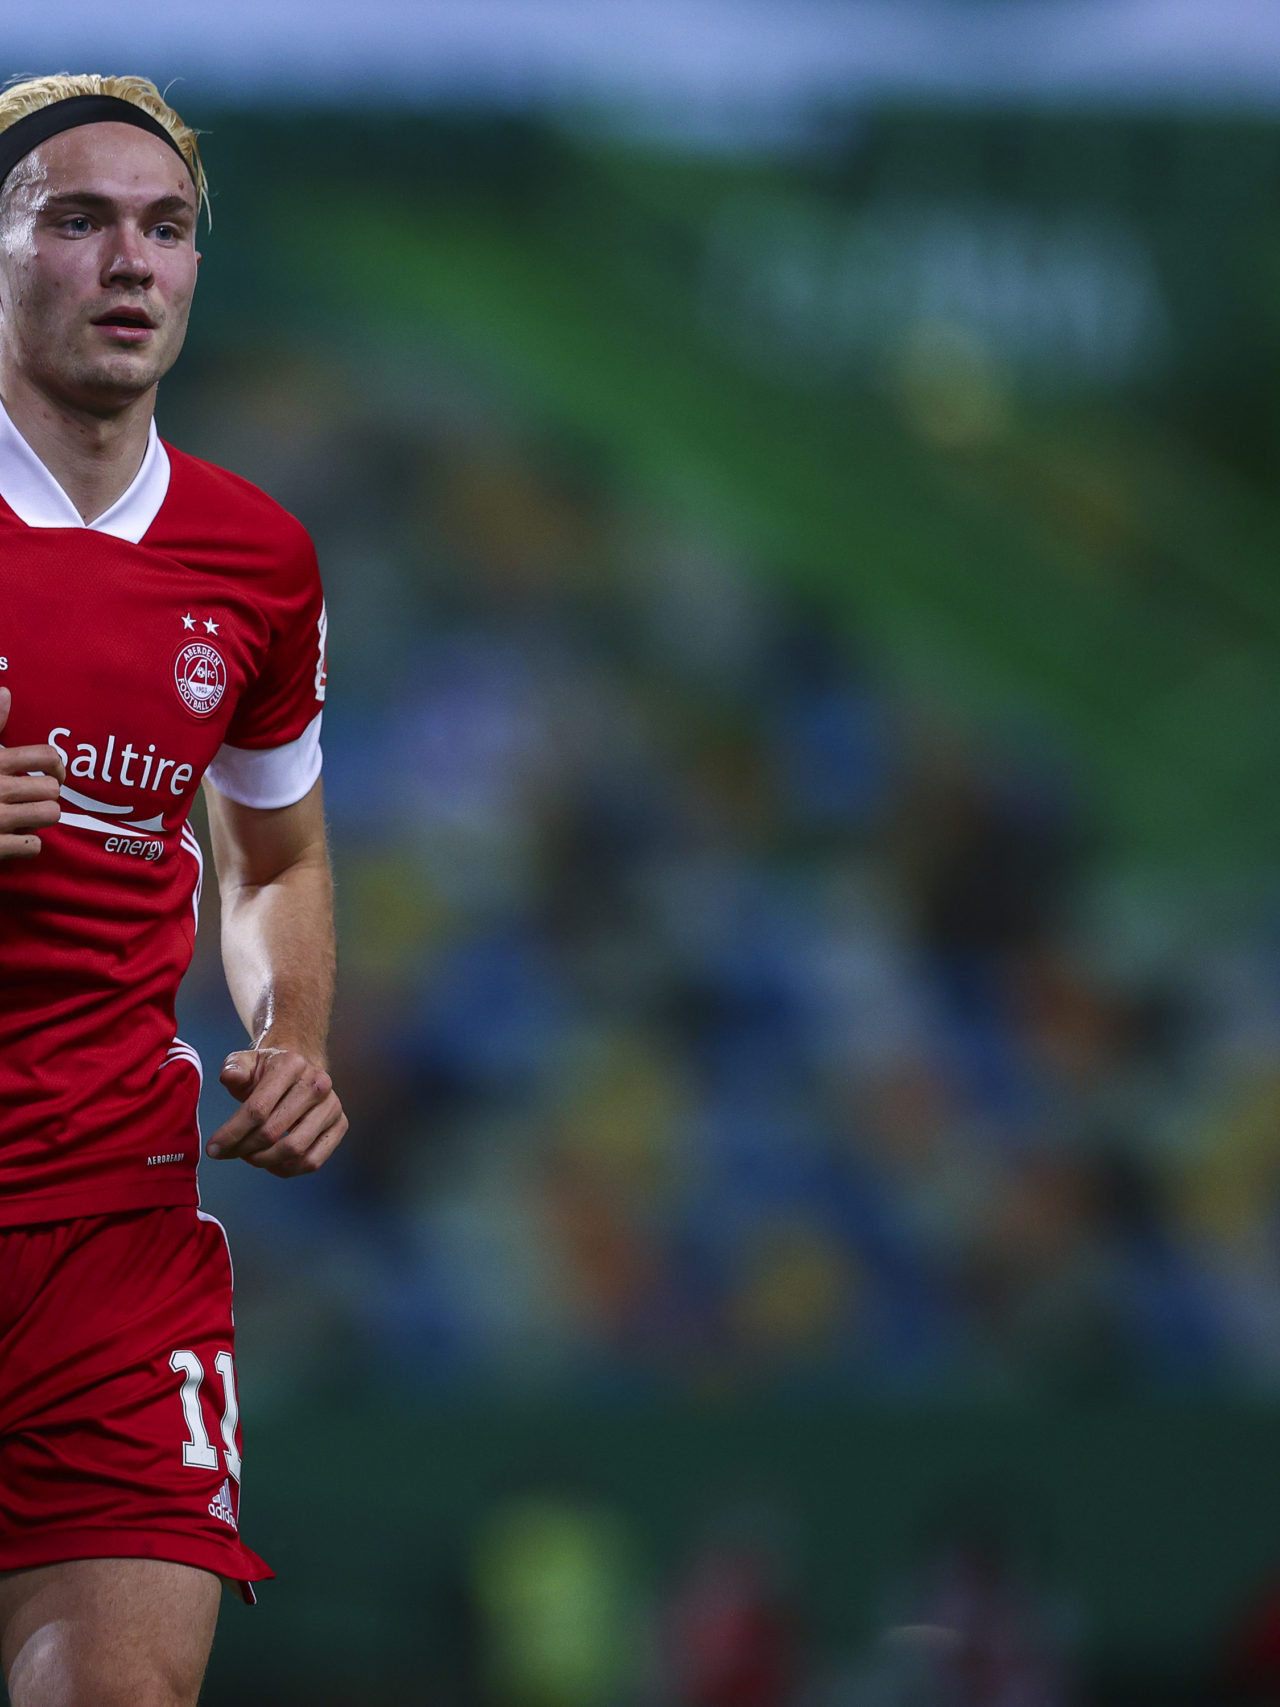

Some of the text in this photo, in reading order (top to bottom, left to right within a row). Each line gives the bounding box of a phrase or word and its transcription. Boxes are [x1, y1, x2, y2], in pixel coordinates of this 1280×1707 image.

[183, 646, 221, 667] ABERDEEN
[178, 678, 223, 711] FOOTBALL CLUB
[47, 727, 193, 796] Saltire
[104, 836, 164, 861] energy
[147, 1153, 184, 1166] AEROREADY
[169, 1350, 242, 1485] 11
